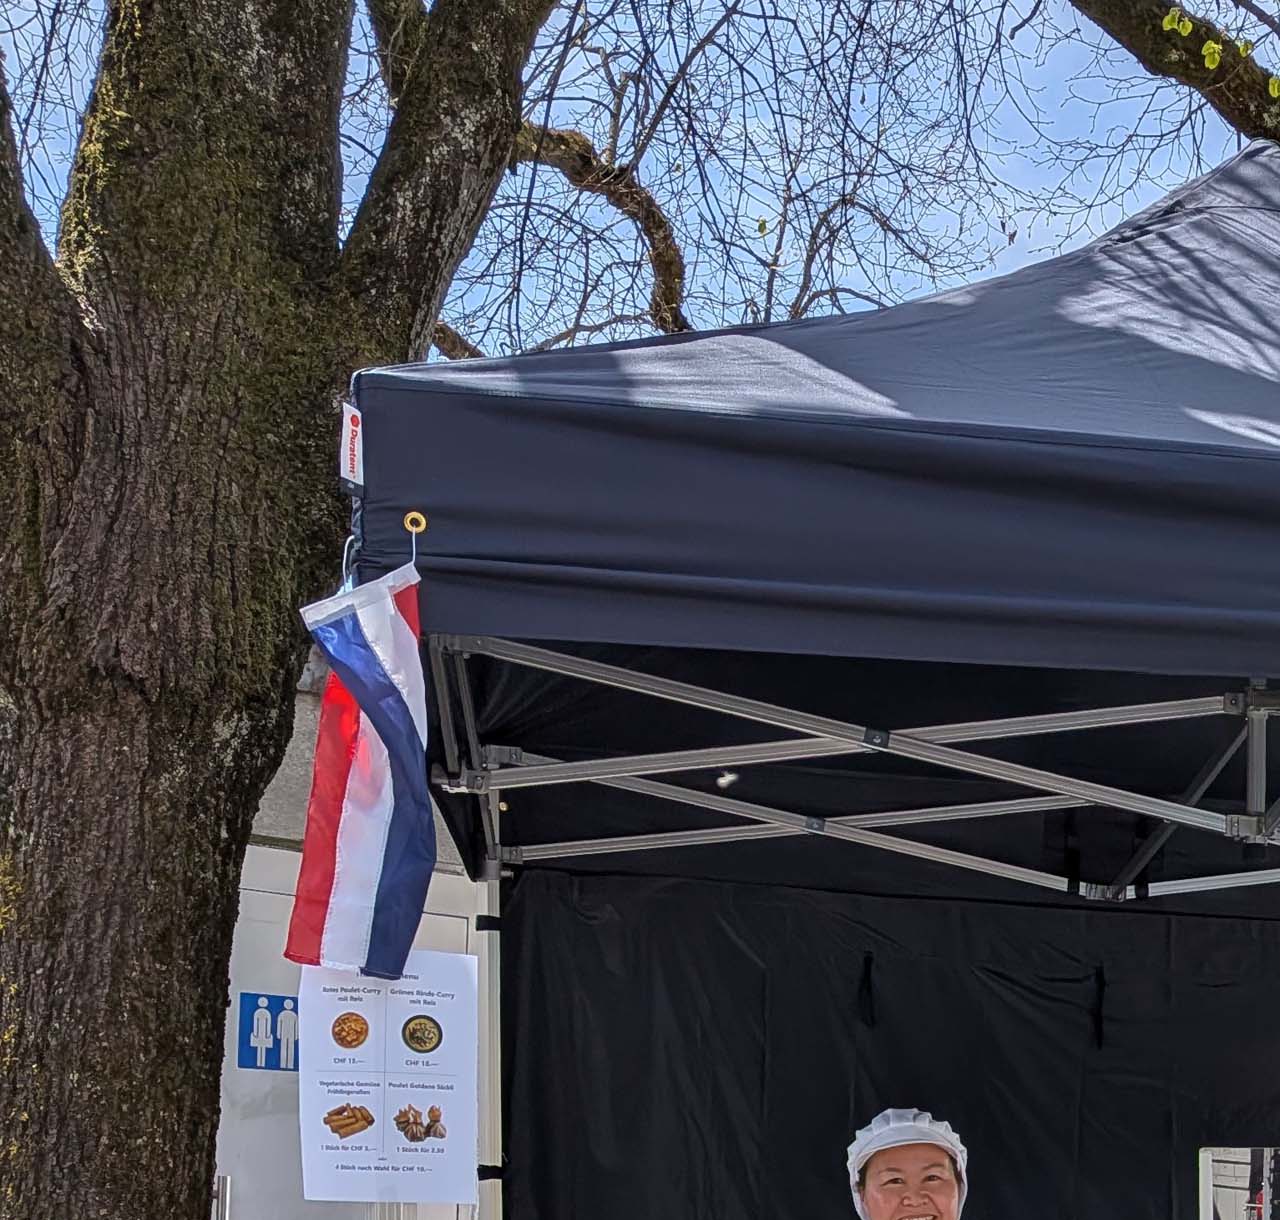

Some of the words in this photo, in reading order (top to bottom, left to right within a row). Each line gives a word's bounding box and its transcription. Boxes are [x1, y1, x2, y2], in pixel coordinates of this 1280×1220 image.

[349, 428, 358, 475] Duratent
[339, 986, 382, 996] Poulet-Curry
[389, 987, 415, 997] Grünes
[408, 998, 422, 1006] mit
[333, 1057, 346, 1065] CHF
[405, 1059, 419, 1067] CHF
[319, 1080, 354, 1089] Vegetarische
[355, 1080, 381, 1088] Gemüse
[409, 1082, 436, 1090] Goldene
[340, 1163, 357, 1171] Stück
